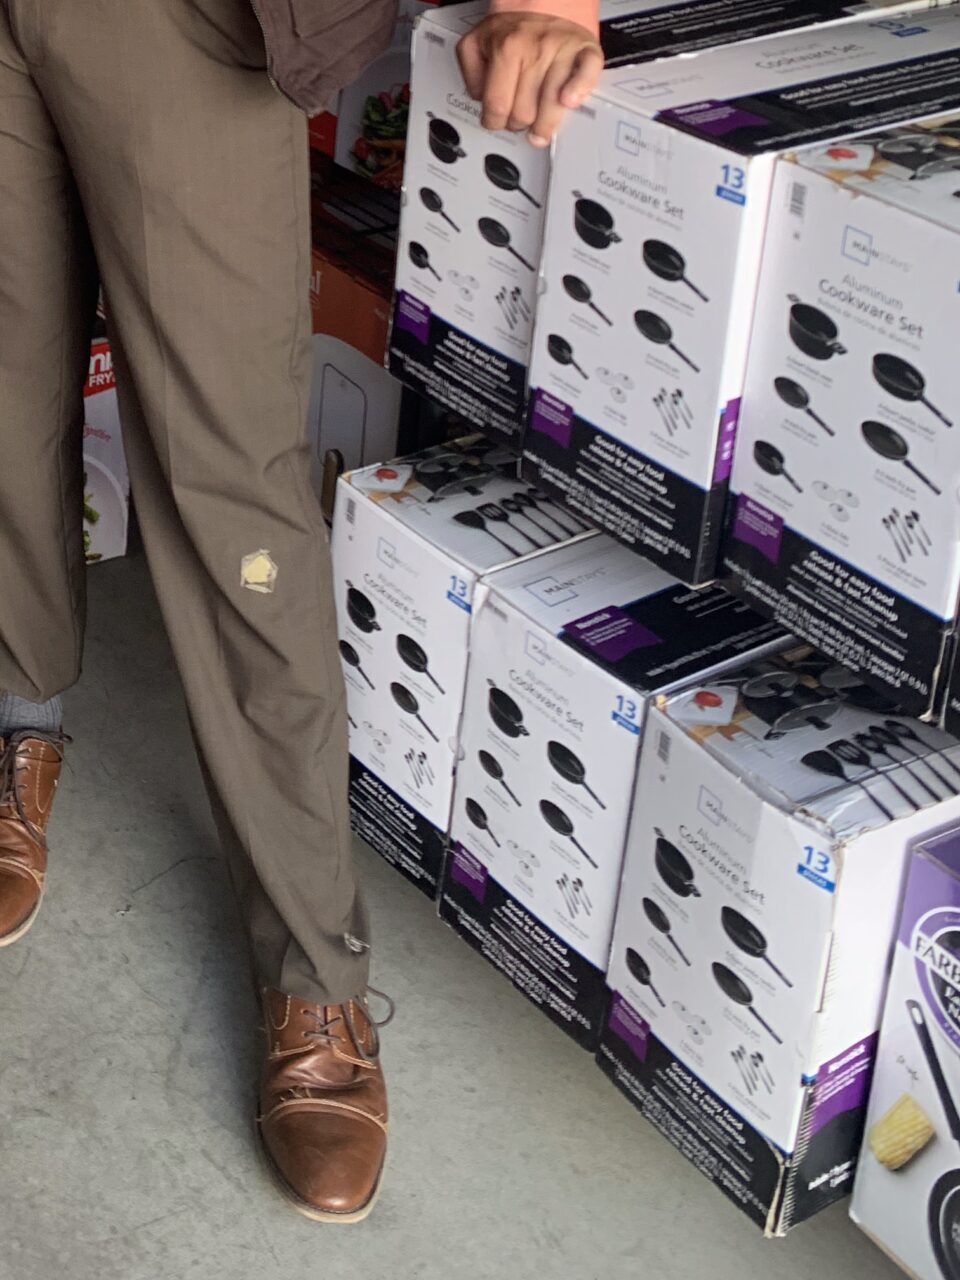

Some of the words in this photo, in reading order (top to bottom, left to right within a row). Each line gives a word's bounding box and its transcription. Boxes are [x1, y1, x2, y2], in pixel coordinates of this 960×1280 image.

[597, 170, 662, 209] Cookware
[663, 201, 685, 220] Set
[616, 165, 668, 195] Aluminum
[720, 164, 745, 190] 13
[819, 278, 895, 325] Cookware
[898, 316, 924, 340] Set
[841, 273, 904, 310] Aluminum
[450, 575, 467, 597] 13
[543, 567, 607, 596] MAINSTAYS
[802, 559, 834, 584] release
[842, 583, 861, 599] fast
[861, 595, 899, 622] cleanup
[809, 550, 835, 571] Good
[834, 564, 849, 579] for
[848, 575, 871, 594] easy
[870, 586, 895, 607] food
[508, 669, 564, 717] Cookware
[565, 711, 585, 733] Set
[615, 694, 637, 720] 13
[678, 823, 741, 886] Cookware
[742, 880, 766, 906] Set
[697, 826, 748, 874] Aluminum
[803, 845, 831, 874] 13
[670, 1061, 692, 1084] Good
[691, 1079, 705, 1096] for
[703, 1093, 724, 1114] easy
[723, 1109, 744, 1131] food
